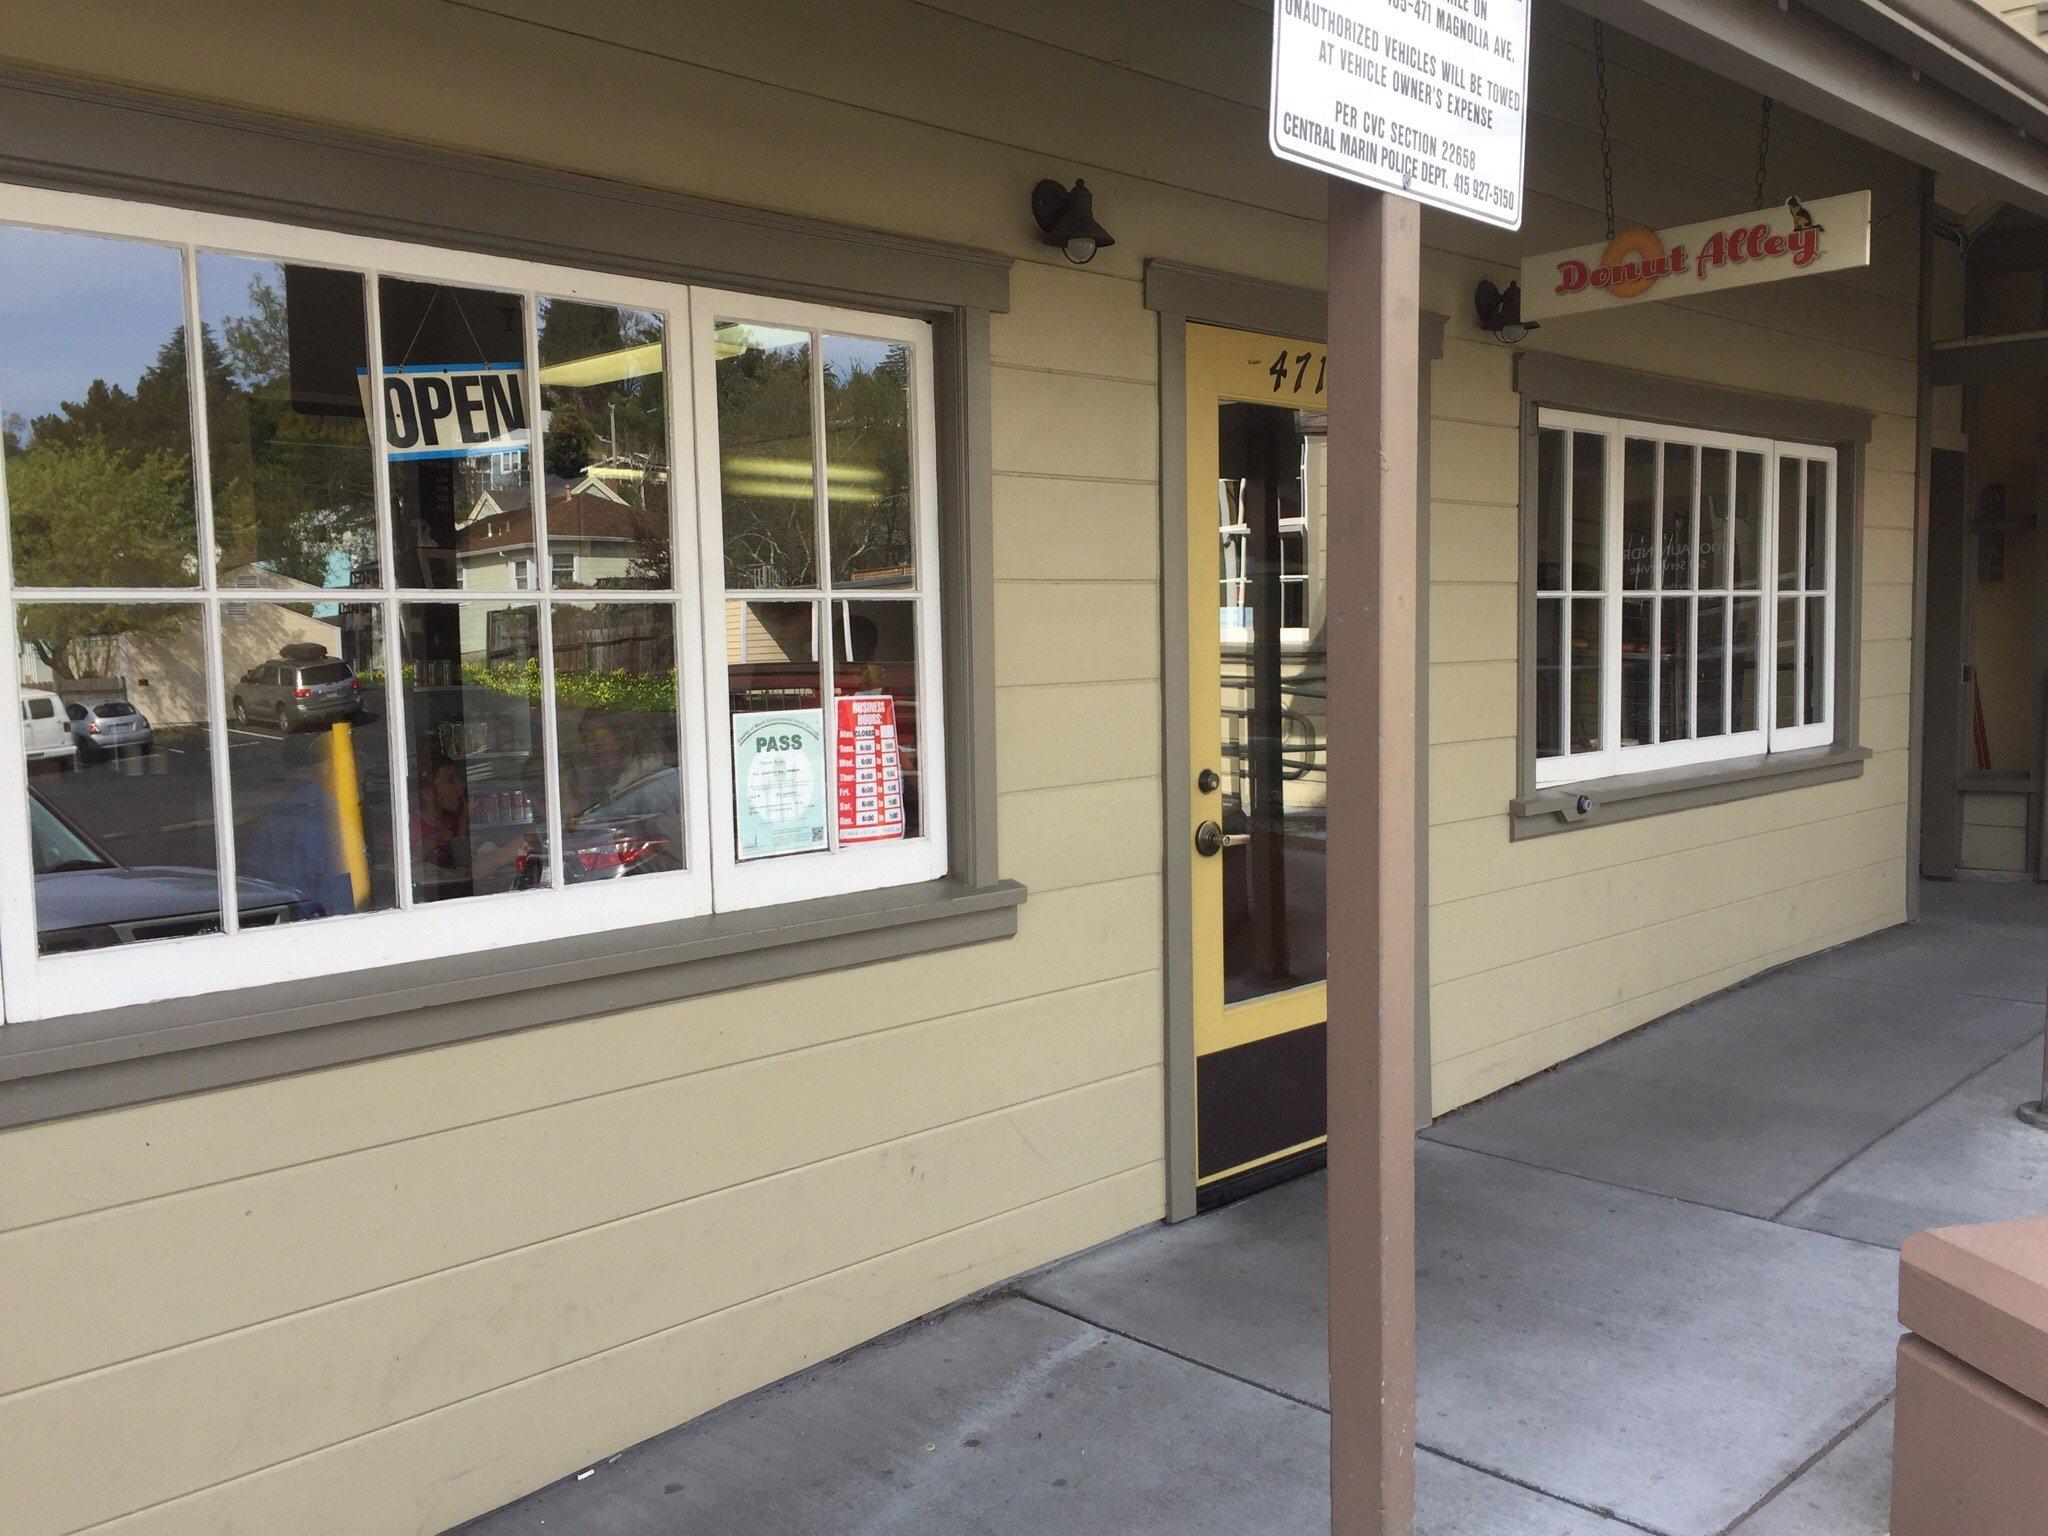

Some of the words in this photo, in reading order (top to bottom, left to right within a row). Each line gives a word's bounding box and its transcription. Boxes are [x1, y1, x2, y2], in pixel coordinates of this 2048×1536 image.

[1436, 7, 1489, 51] MAGNOLIA
[1473, 0, 1487, 21] ON
[1284, 0, 1379, 52] UNAUTHORIZED
[1384, 34, 1437, 77] VEHICLES
[1441, 59, 1466, 90] WILL
[1470, 72, 1483, 97] BE
[1486, 79, 1520, 112] TOWED
[1318, 39, 1335, 66] AT
[1339, 47, 1387, 88] VEHICLE
[1392, 69, 1443, 110] OWNER'S
[1446, 92, 1493, 130] EXPENSE
[1283, 111, 1336, 152] CENTRAL
[1339, 131, 1378, 165] MARIN
[1380, 145, 1418, 179] POLICE
[1421, 160, 1449, 189] DEPT.
[1453, 172, 1470, 196] 415
[1472, 178, 1515, 211] 927-5150
[1335, 99, 1358, 129] PER
[1363, 110, 1385, 139] CVC
[1390, 121, 1437, 157] SECTION
[1441, 140, 1476, 172] 22658
[1554, 243, 1689, 295] Donut
[1696, 223, 1820, 281] Alley
[1269, 349, 1327, 395] 471
[383, 373, 526, 449] OPEN
[756, 734, 803, 753] PASS
[853, 729, 876, 737] CLOSED
